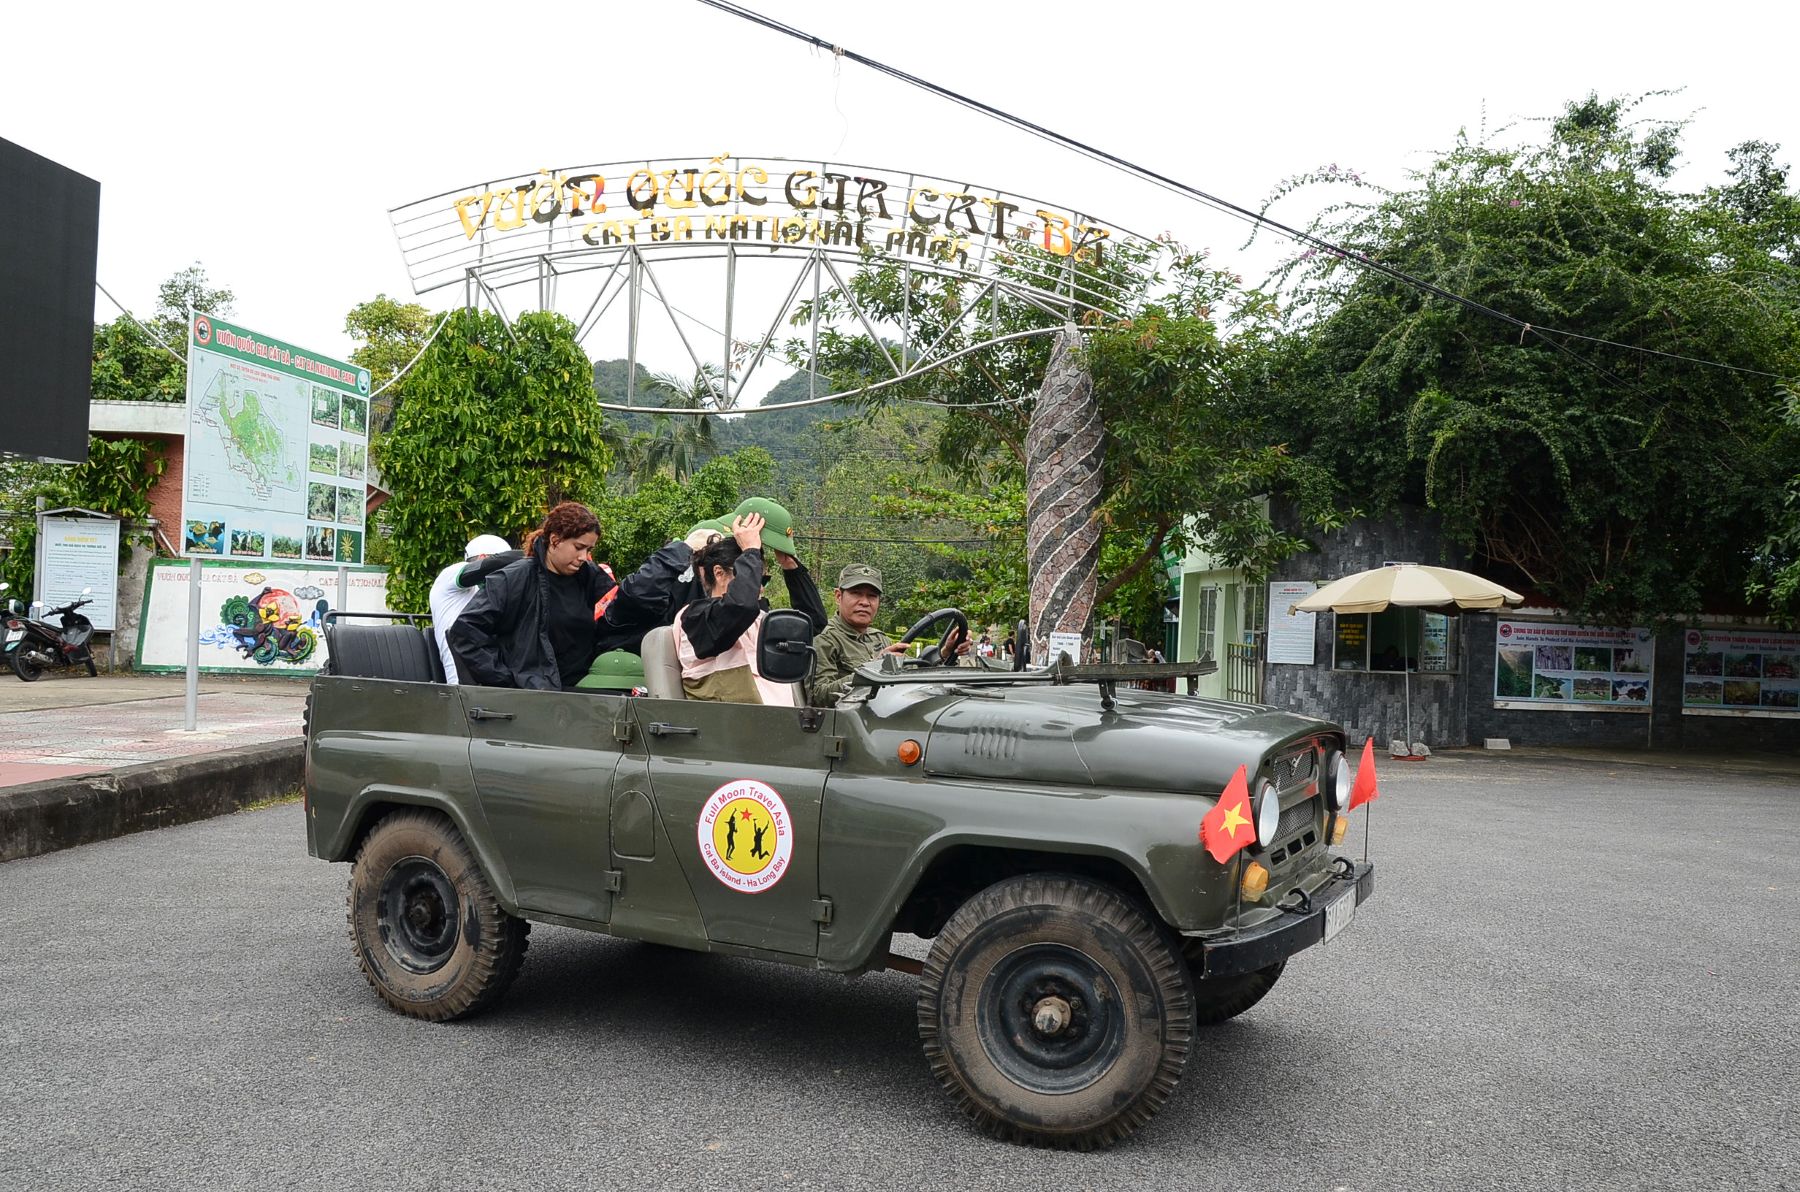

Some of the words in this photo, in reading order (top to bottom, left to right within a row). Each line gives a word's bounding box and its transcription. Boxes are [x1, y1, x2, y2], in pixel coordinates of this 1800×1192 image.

[785, 169, 893, 220] GIA
[582, 218, 640, 246] CAT
[651, 216, 693, 242] BA
[705, 803, 719, 825] Full
[717, 788, 745, 804] Moon
[749, 787, 775, 810] Travel
[773, 811, 785, 836] Asia
[703, 843, 713, 859] Cat
[710, 858, 720, 870] Ba
[746, 879, 758, 887] Ha
[758, 870, 776, 884] Long
[773, 856, 785, 872] Bay
